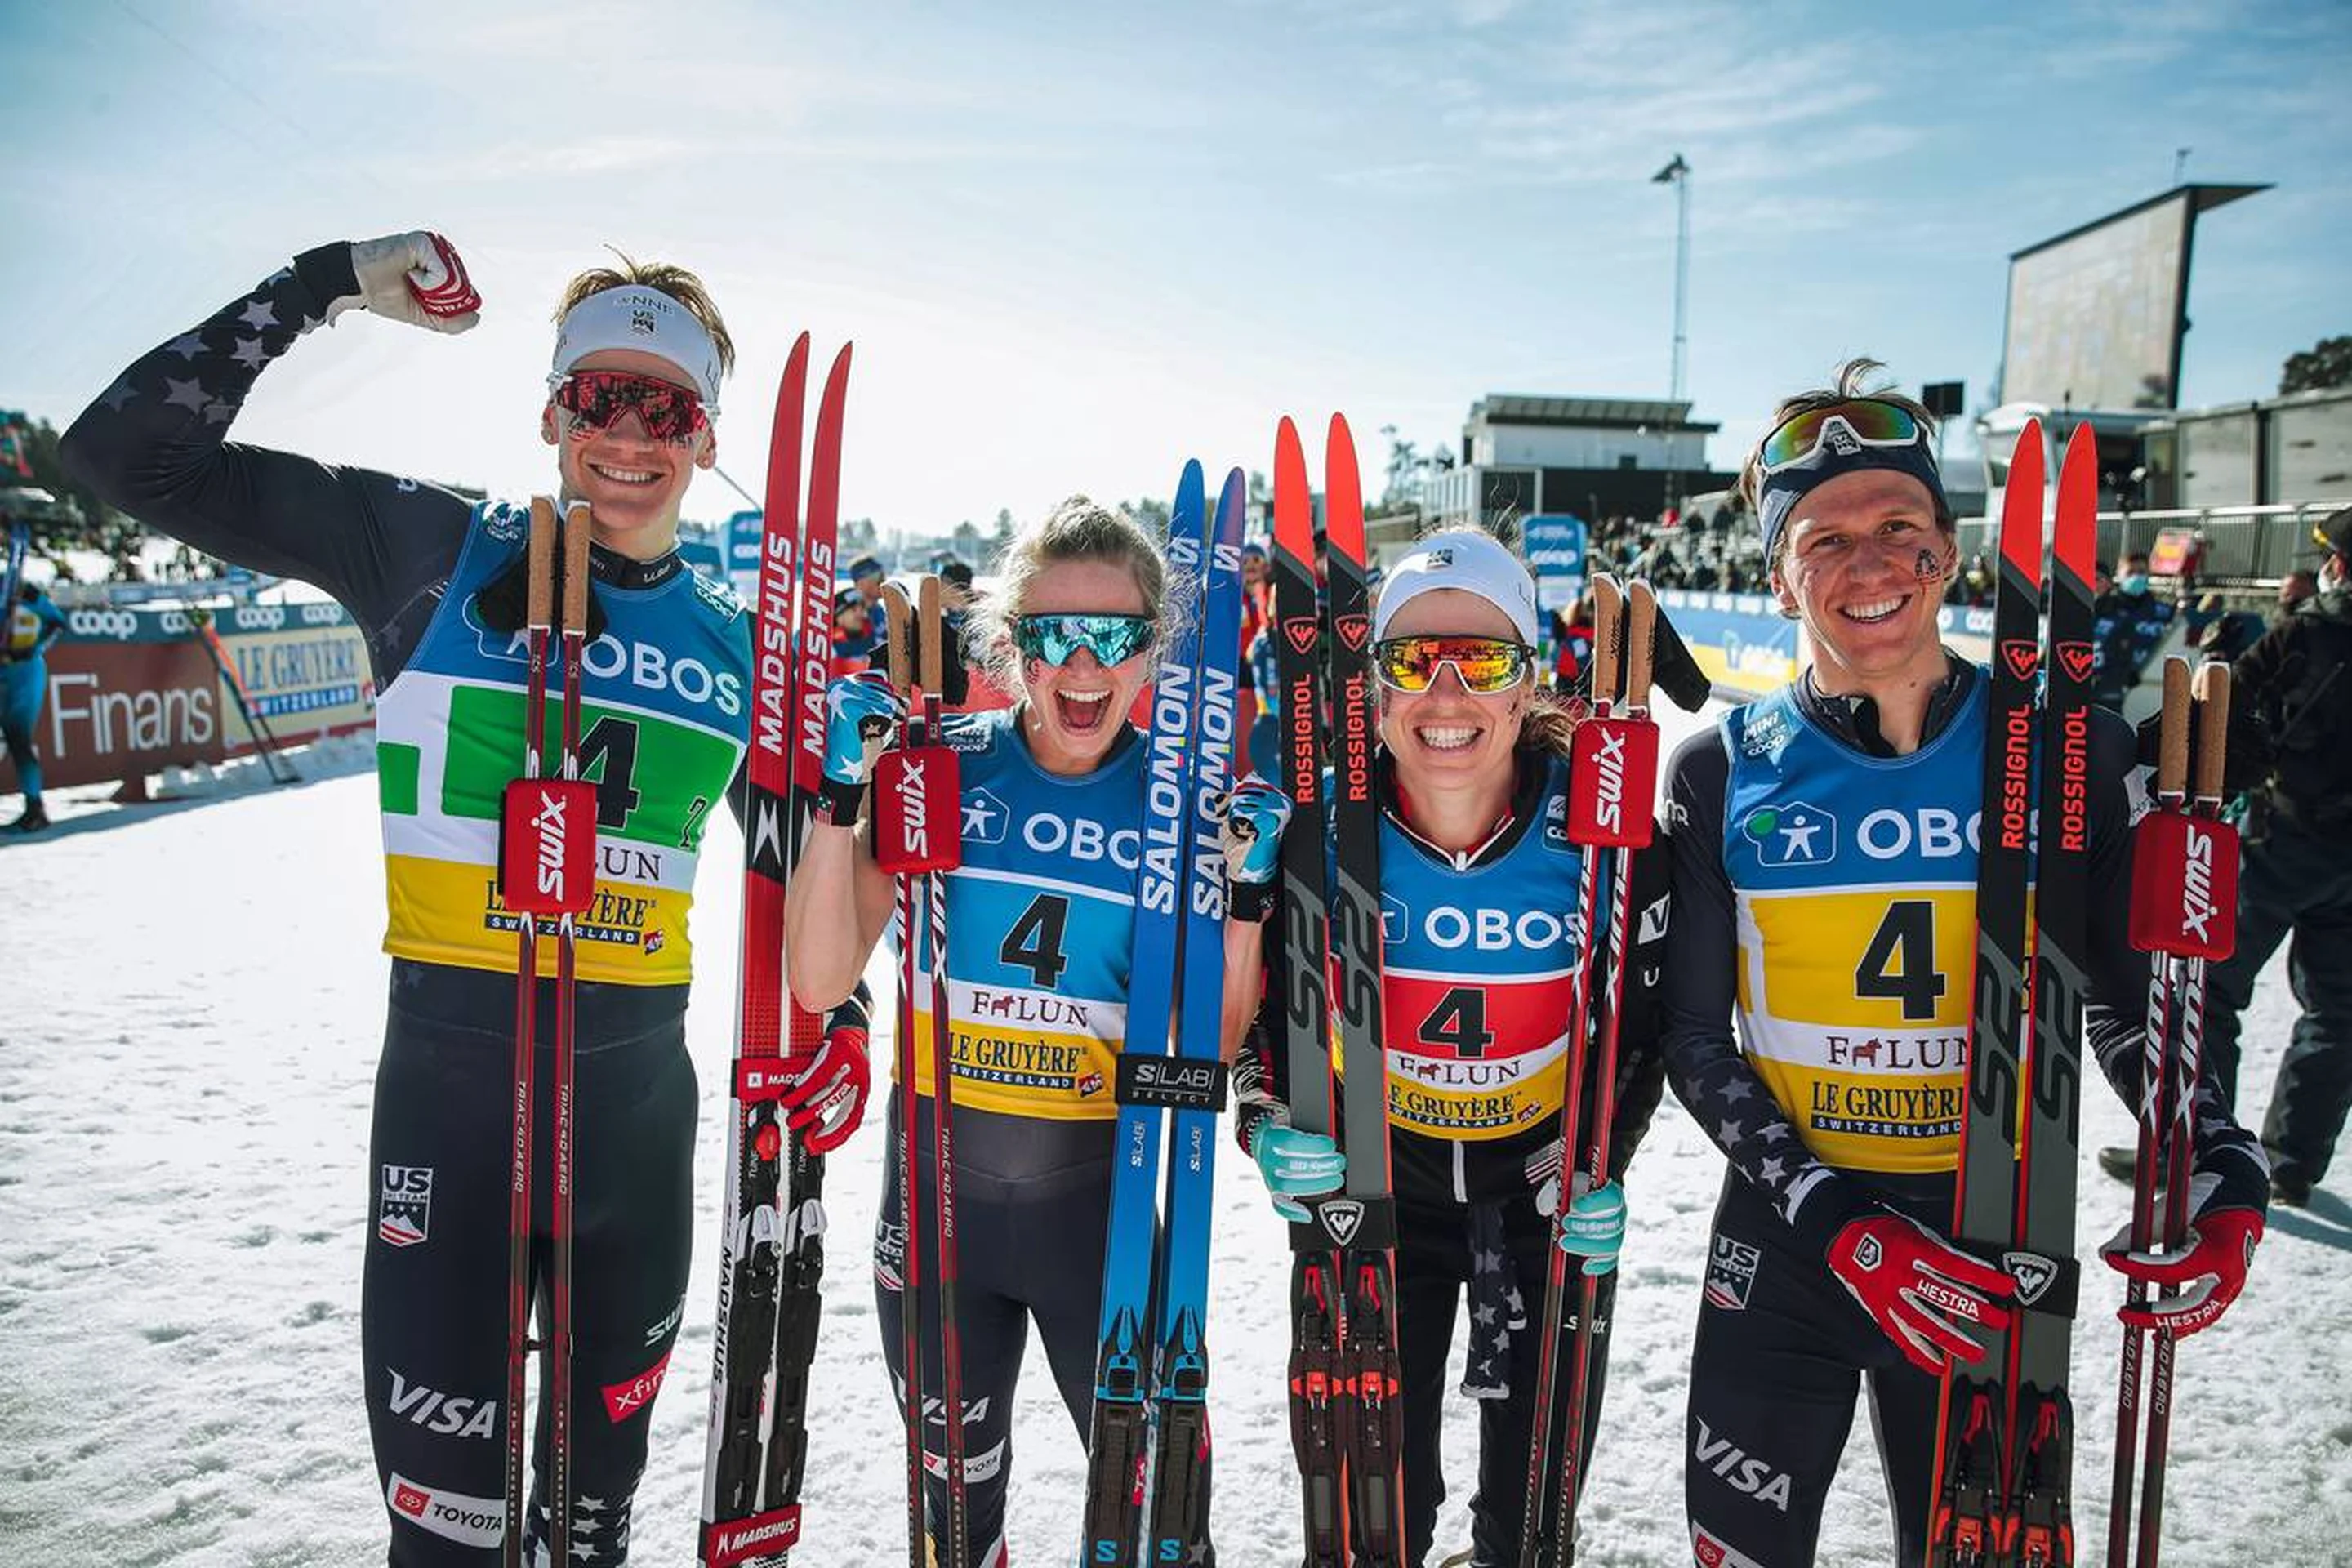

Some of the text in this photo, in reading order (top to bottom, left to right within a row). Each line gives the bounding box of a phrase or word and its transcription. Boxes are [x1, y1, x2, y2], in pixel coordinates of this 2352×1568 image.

[69, 610, 137, 641] coop
[236, 606, 285, 630] coop
[301, 604, 343, 626] coop
[759, 532, 792, 755] MADSHUS
[803, 539, 832, 758] MADSHUS
[582, 634, 742, 717] OBOS
[48, 672, 213, 760] Finans
[1294, 673, 1314, 804] ROSSIGNOL
[1346, 670, 1367, 801] ROSSIGNOL
[1143, 661, 1191, 915] SALOMON
[1192, 666, 1235, 921] SALOMON
[2002, 703, 2030, 850] ROSSIGNOL
[2060, 704, 2087, 852] ROSSIGNOL
[1856, 808, 1984, 859] OB
[998, 893, 1071, 991] 4
[1854, 899, 1947, 1022] 4
[976, 1037, 1080, 1074] GRUYÈRE
[1416, 987, 1495, 1060] 4
[1407, 1091, 1516, 1119] GRUYÈRE
[1812, 1081, 1838, 1112] LE
[385, 1167, 430, 1194] US
[1714, 1236, 1757, 1268] US
[712, 1249, 733, 1386] MADSHUS
[1916, 1278, 1980, 1317] HESTRA
[2155, 1299, 2221, 1328] HESTRA
[386, 1365, 497, 1440] VISA
[1695, 1415, 1793, 1513] VISA
[432, 1503, 504, 1533] TOYOTA
[730, 1517, 797, 1552] MADSHUS
[1095, 1540, 1118, 1563] S
[1159, 1539, 1181, 1561] S
